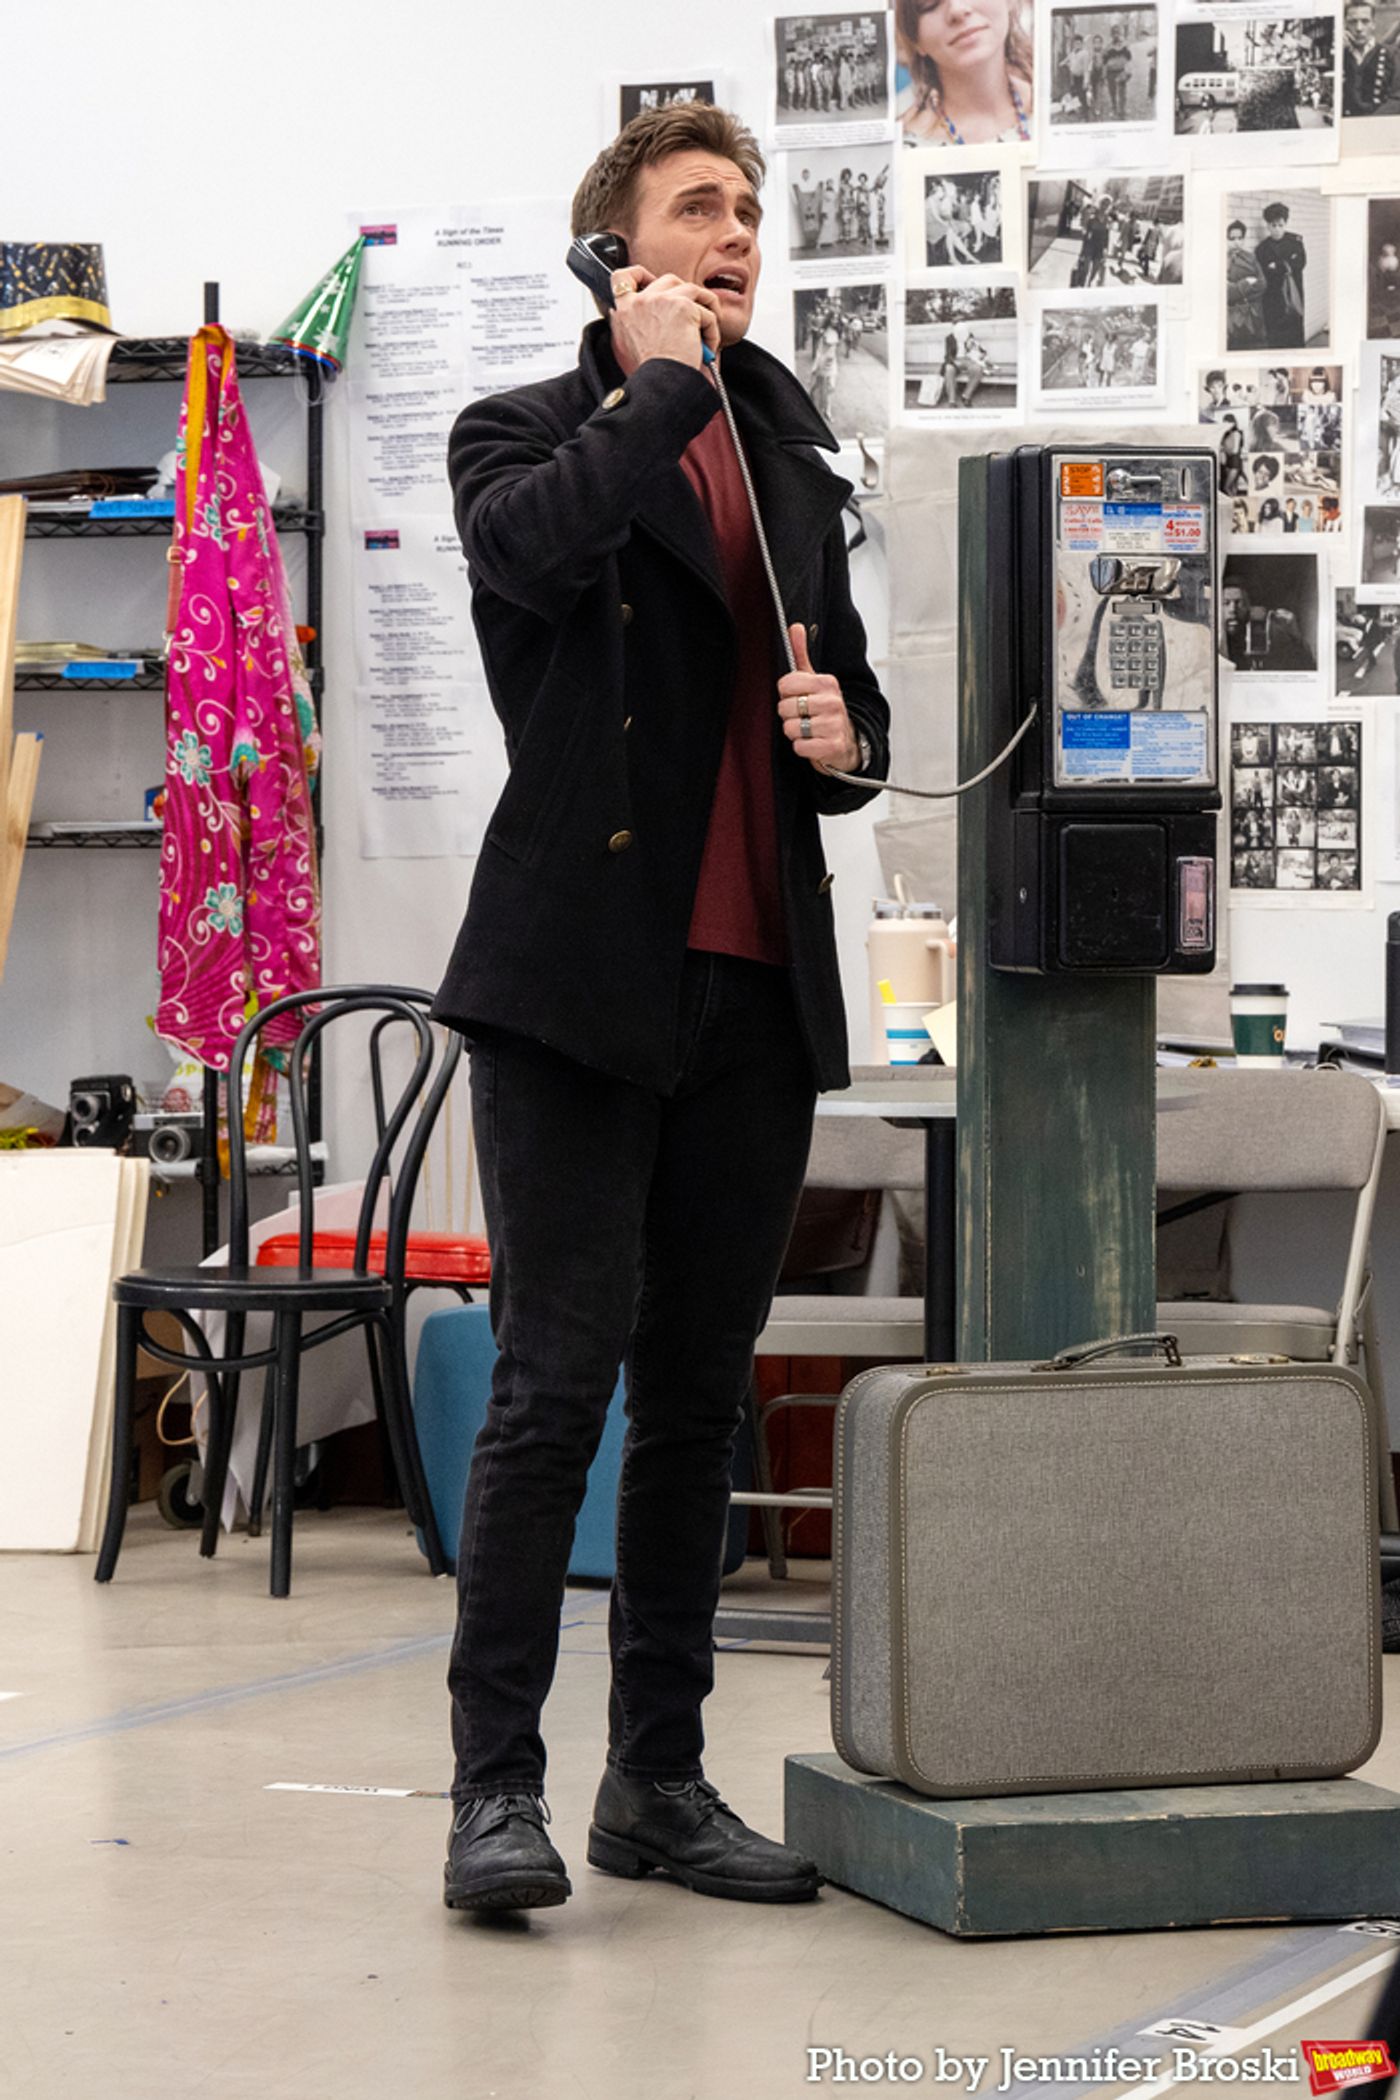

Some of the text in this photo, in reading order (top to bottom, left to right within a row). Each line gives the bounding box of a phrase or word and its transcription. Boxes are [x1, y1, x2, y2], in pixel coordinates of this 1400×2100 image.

[442, 228, 459, 238] Sign
[460, 227, 468, 236] of
[482, 226, 504, 234] Times
[436, 237, 501, 248] RUNNING ORDER
[1166, 519, 1174, 531] 4
